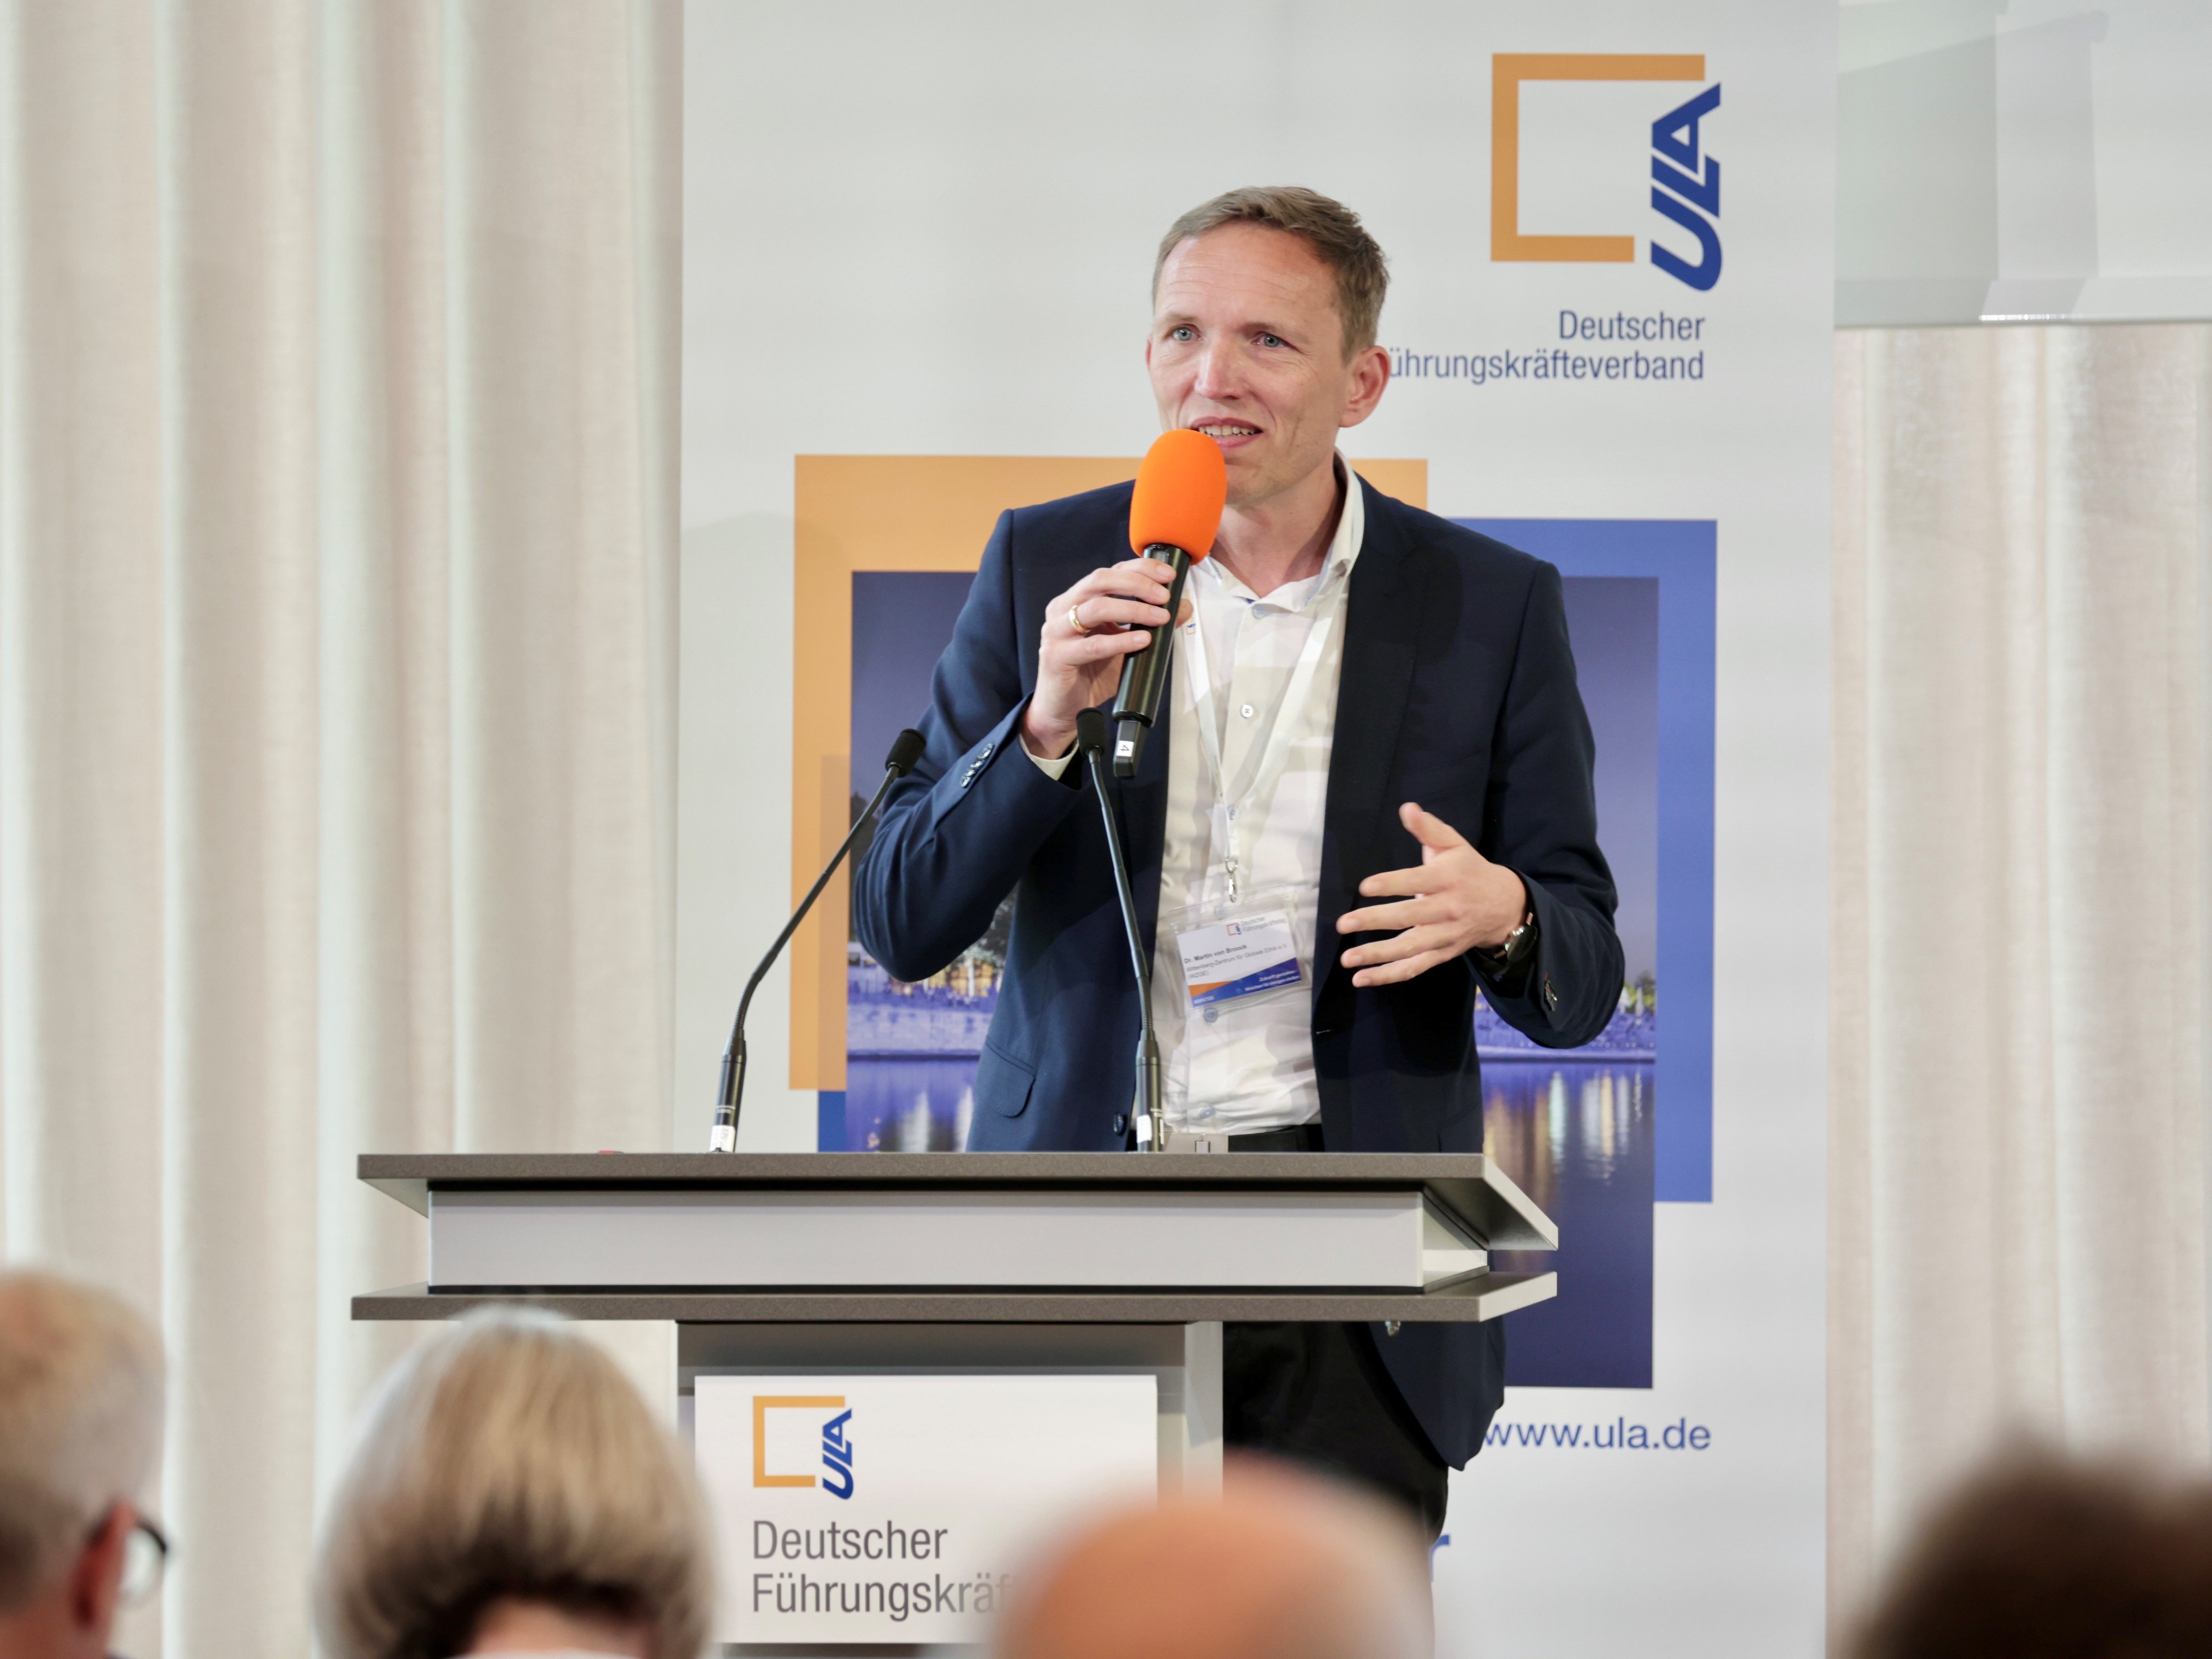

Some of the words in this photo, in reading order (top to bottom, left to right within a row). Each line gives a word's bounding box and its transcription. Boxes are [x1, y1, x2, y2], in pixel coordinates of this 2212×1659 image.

[1650, 82, 1722, 292] ULA
[1559, 310, 1705, 341] Deutscher
[1390, 347, 1704, 385] ührungskräfteverband
[822, 1408, 854, 1500] ULA
[1484, 1417, 1711, 1451] www.ula.de
[753, 1520, 948, 1560] Deutscher
[753, 1572, 1010, 1622] Führungskräf
